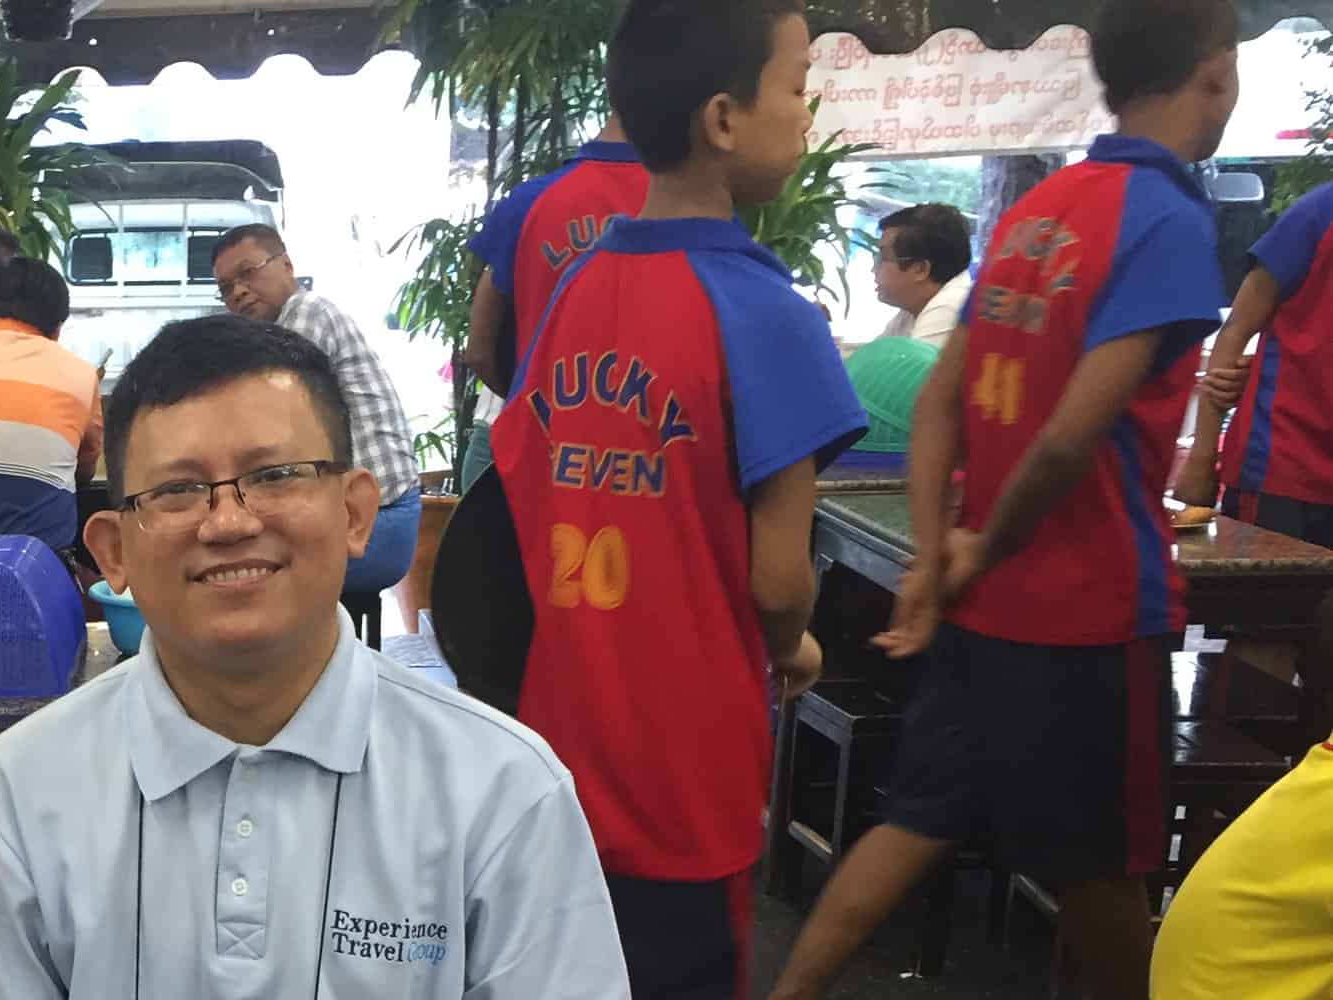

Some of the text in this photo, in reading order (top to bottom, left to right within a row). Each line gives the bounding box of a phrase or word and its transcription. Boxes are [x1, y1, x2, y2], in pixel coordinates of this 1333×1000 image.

[540, 214, 614, 271] LU
[549, 442, 667, 498] EVEN
[548, 522, 630, 611] 20
[330, 908, 449, 941] Experience
[331, 930, 404, 963] Travel
